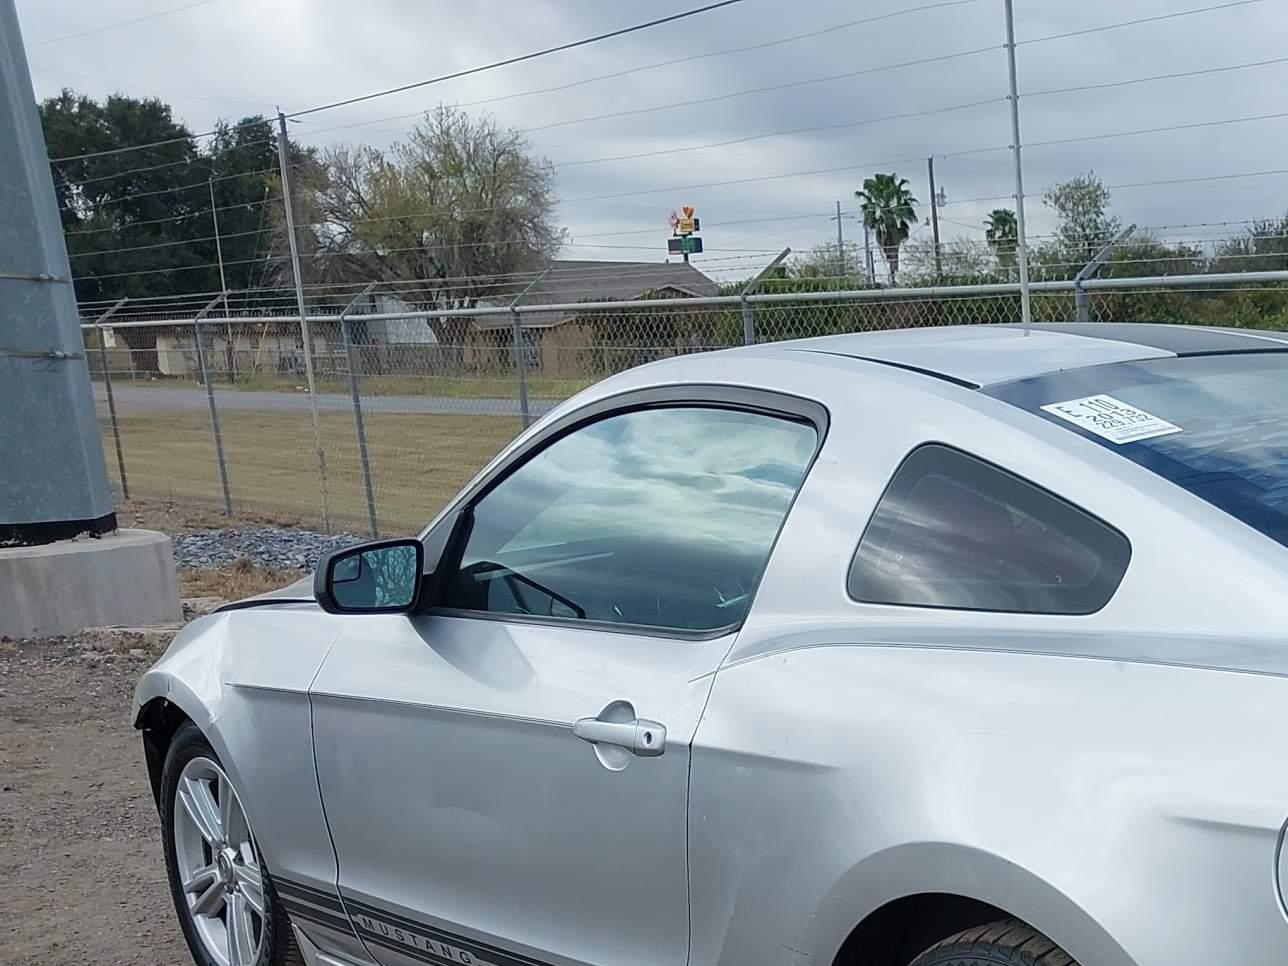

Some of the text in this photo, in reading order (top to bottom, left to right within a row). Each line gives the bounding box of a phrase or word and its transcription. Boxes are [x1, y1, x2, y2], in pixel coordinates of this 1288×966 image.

[1055, 398, 1120, 418] E 110
[1086, 408, 1137, 423] 2013
[362, 917, 472, 964] MUSTANG
